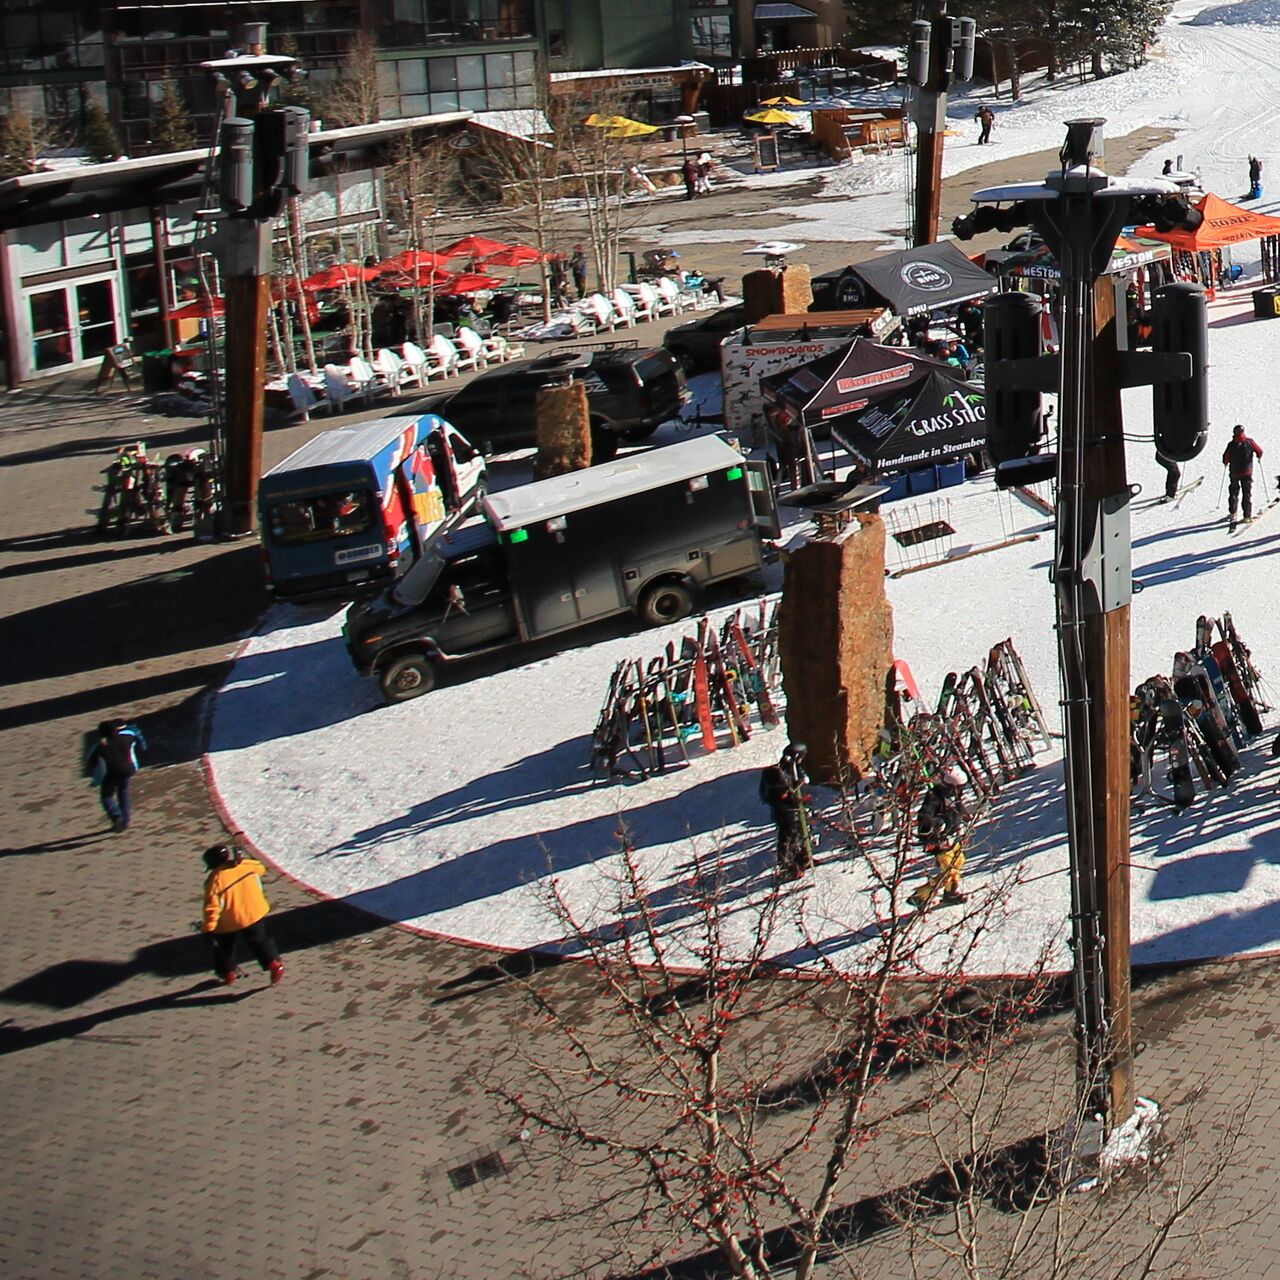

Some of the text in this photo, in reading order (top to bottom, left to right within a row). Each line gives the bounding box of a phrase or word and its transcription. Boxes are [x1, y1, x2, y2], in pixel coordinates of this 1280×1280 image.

[1209, 214, 1252, 228] ROMP
[917, 272, 940, 285] RMU
[907, 303, 927, 316] RMU
[745, 344, 825, 357] SNOWBOARDS
[911, 410, 953, 436] GRASS
[877, 450, 930, 469] Handmade
[931, 445, 942, 456] in
